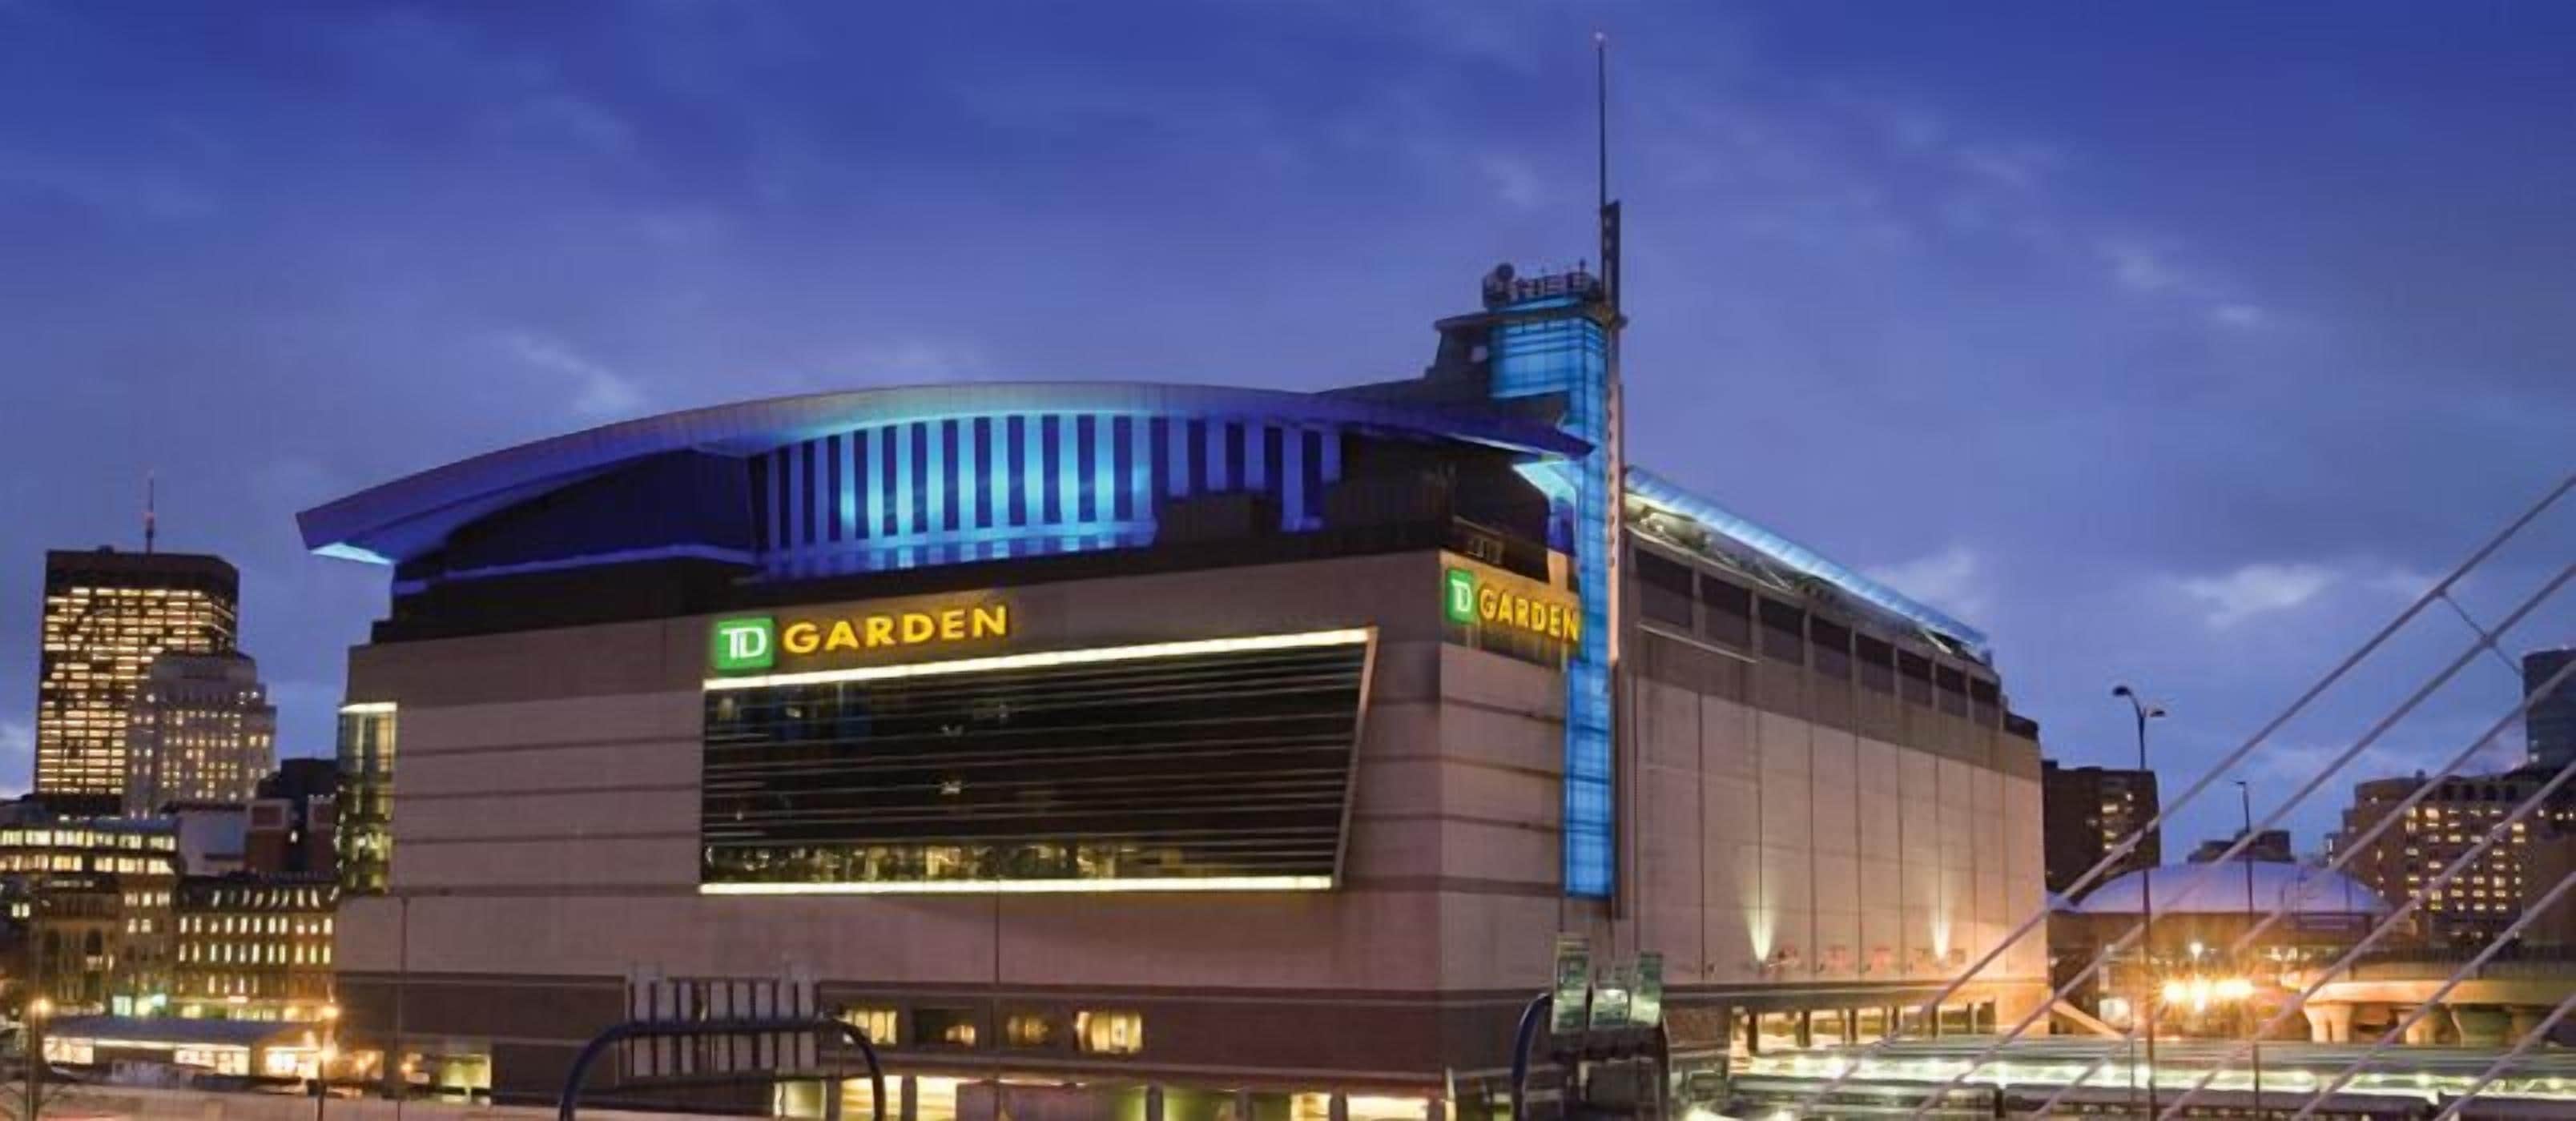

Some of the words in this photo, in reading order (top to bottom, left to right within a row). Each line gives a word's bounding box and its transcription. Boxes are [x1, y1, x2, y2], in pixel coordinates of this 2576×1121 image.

[722, 626, 767, 659] TD
[783, 605, 1008, 654] GARDEN
[1479, 589, 1579, 641] GARDEN
